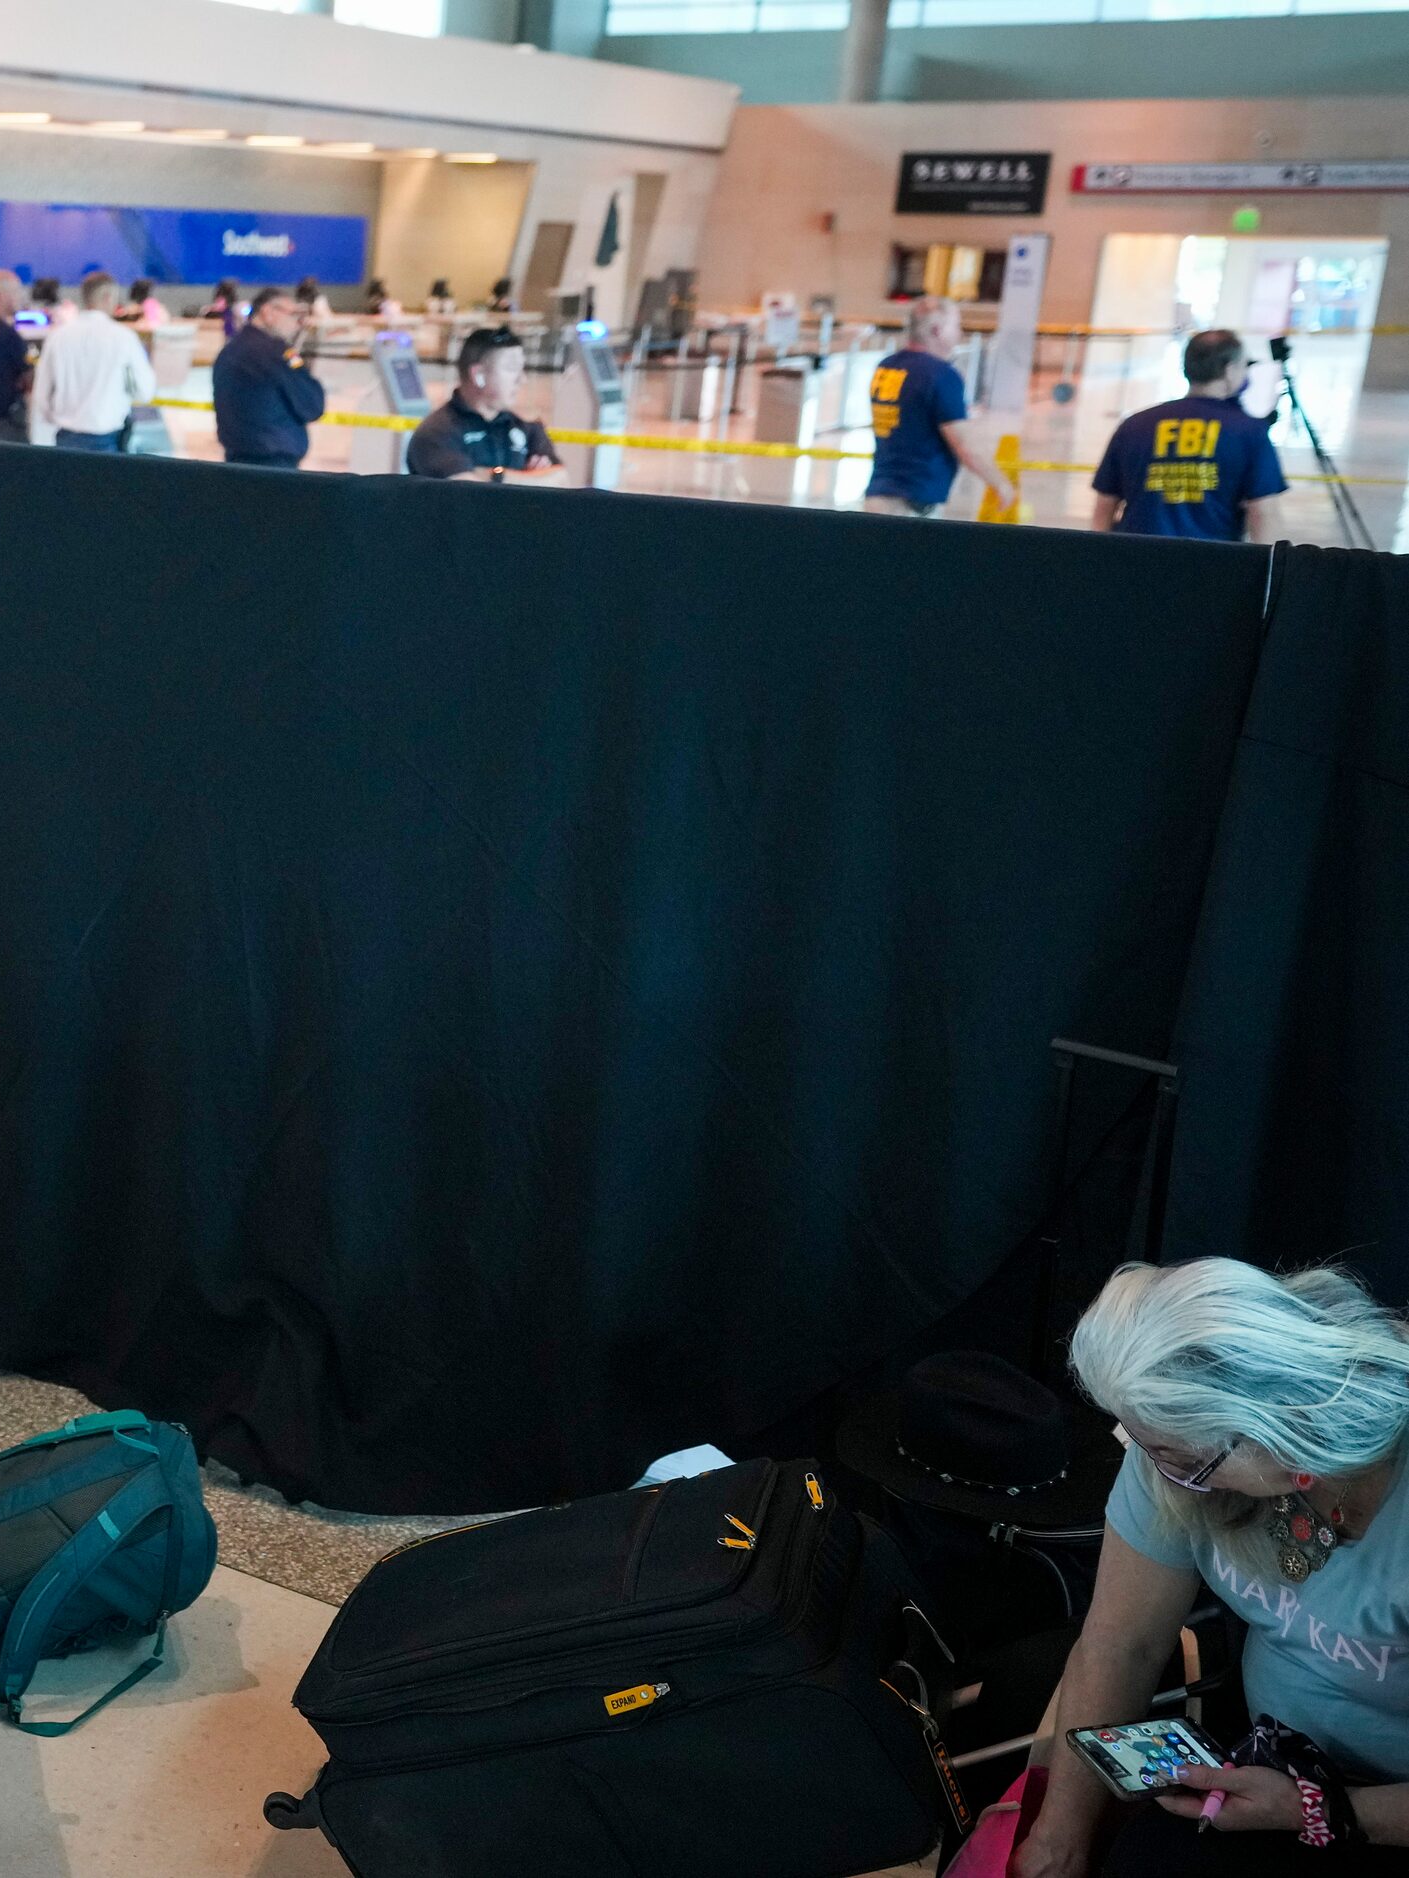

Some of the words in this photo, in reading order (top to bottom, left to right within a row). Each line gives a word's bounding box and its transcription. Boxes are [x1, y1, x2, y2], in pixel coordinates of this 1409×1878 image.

[912, 159, 1035, 182] SEWELL
[1154, 418, 1221, 457] FBI
[1212, 1543, 1301, 1638] MARY
[1308, 1613, 1392, 1682] KAY
[610, 1694, 637, 1710] EXPAND
